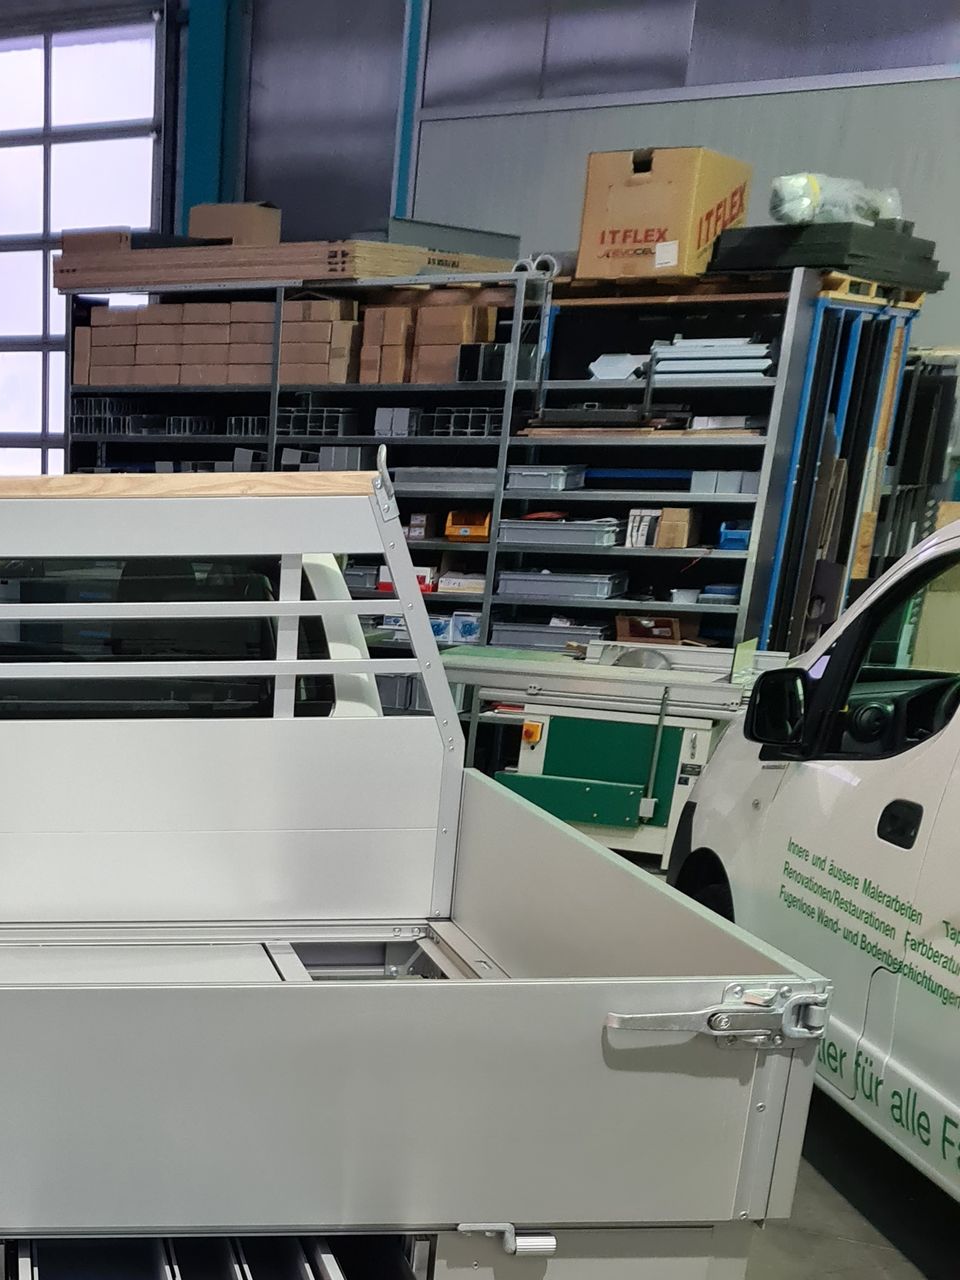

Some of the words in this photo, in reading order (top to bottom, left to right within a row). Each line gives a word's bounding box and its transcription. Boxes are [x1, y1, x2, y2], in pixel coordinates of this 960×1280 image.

[599, 228, 669, 245] ITFLEX
[779, 884, 815, 919] Fugenlose
[817, 907, 841, 933] Wand-
[843, 927, 858, 945] und
[787, 837, 810, 861] Innere
[812, 854, 827, 871] und
[828, 859, 859, 890] äussere
[862, 878, 923, 925] Malerarbeiten
[855, 1050, 883, 1107] für
[890, 1087, 931, 1147] alle
